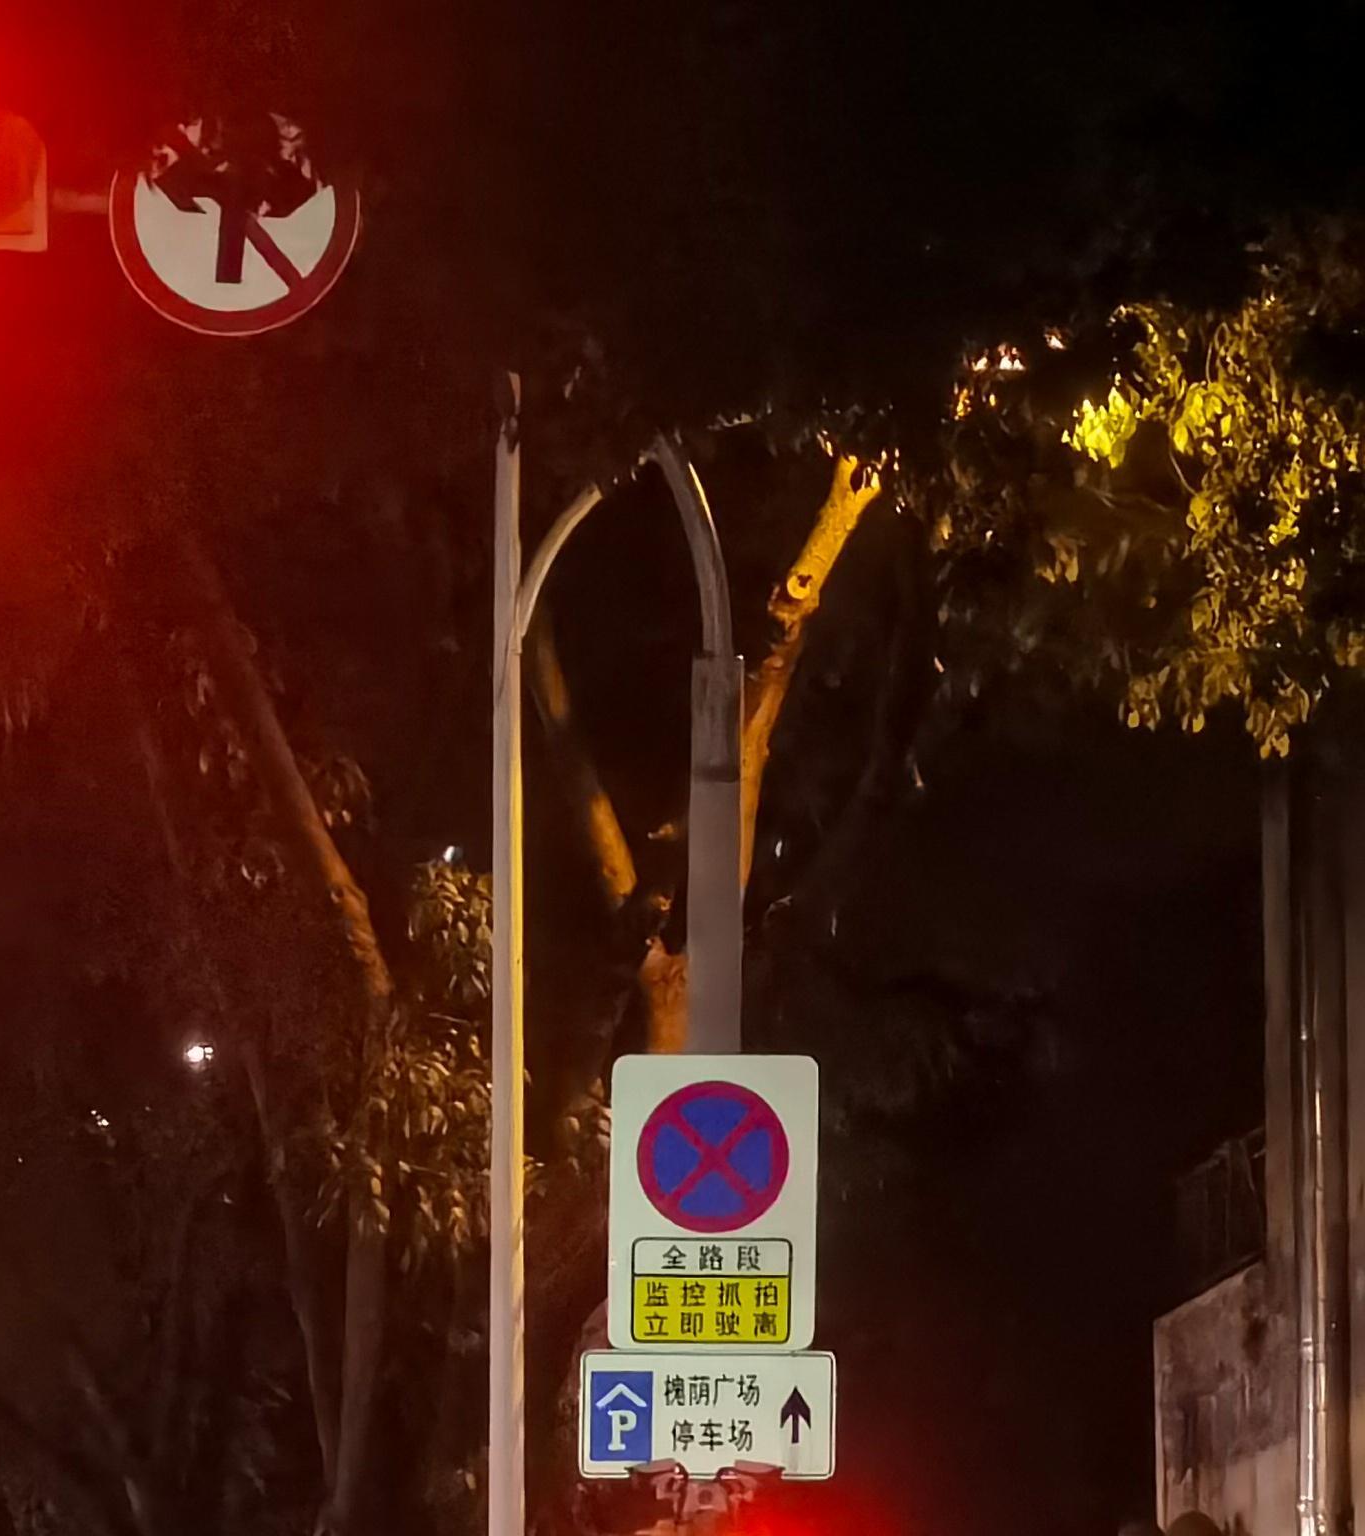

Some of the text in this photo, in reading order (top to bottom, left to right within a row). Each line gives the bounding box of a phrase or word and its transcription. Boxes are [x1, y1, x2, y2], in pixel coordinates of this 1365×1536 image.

[661, 1244, 761, 1271] 全路段
[644, 1281, 778, 1307] 监控抓拍
[644, 1312, 777, 1337] 立即驶离
[664, 1374, 760, 1407] 槐荫广场
[671, 1419, 754, 1452] 停车场
